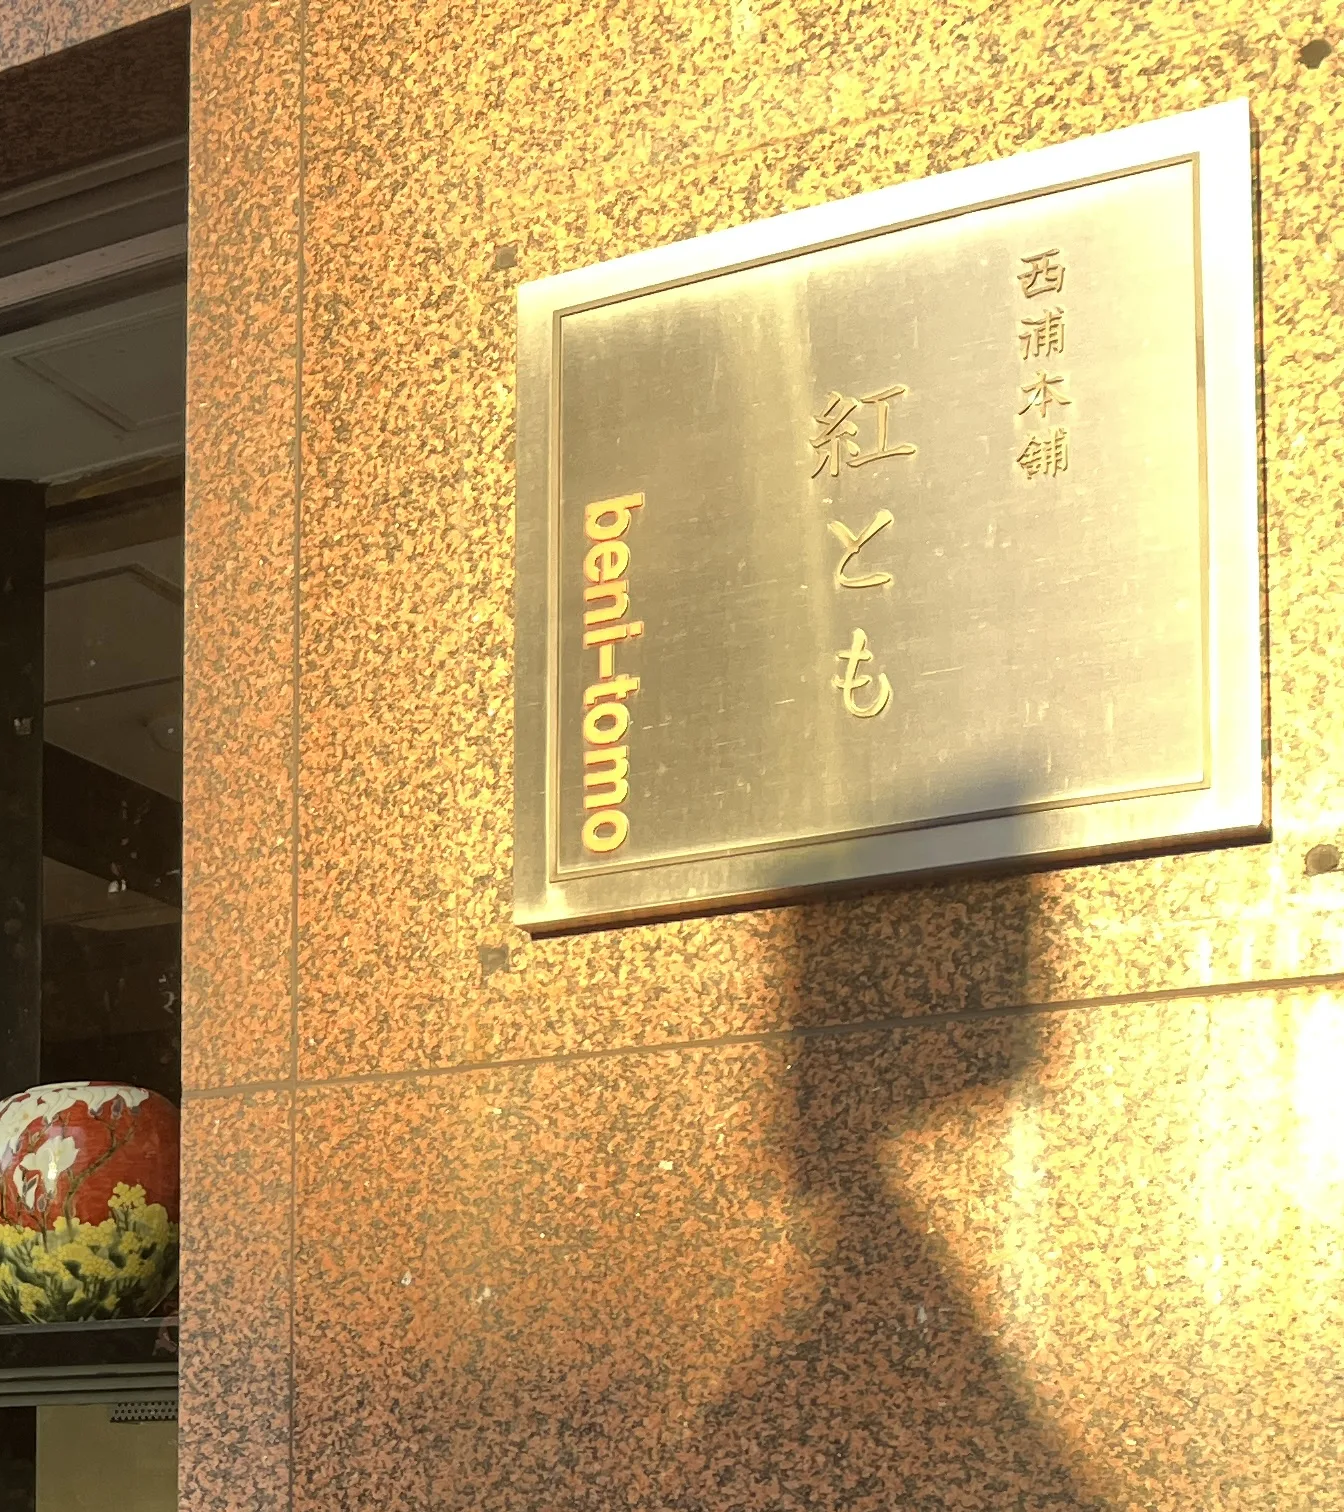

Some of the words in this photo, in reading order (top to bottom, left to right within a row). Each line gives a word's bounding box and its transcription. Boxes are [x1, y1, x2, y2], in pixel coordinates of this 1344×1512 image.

[1016, 247, 1072, 480] 西浦本舗
[582, 492, 646, 853] beni-tomo
[809, 384, 916, 718] 紅とも
